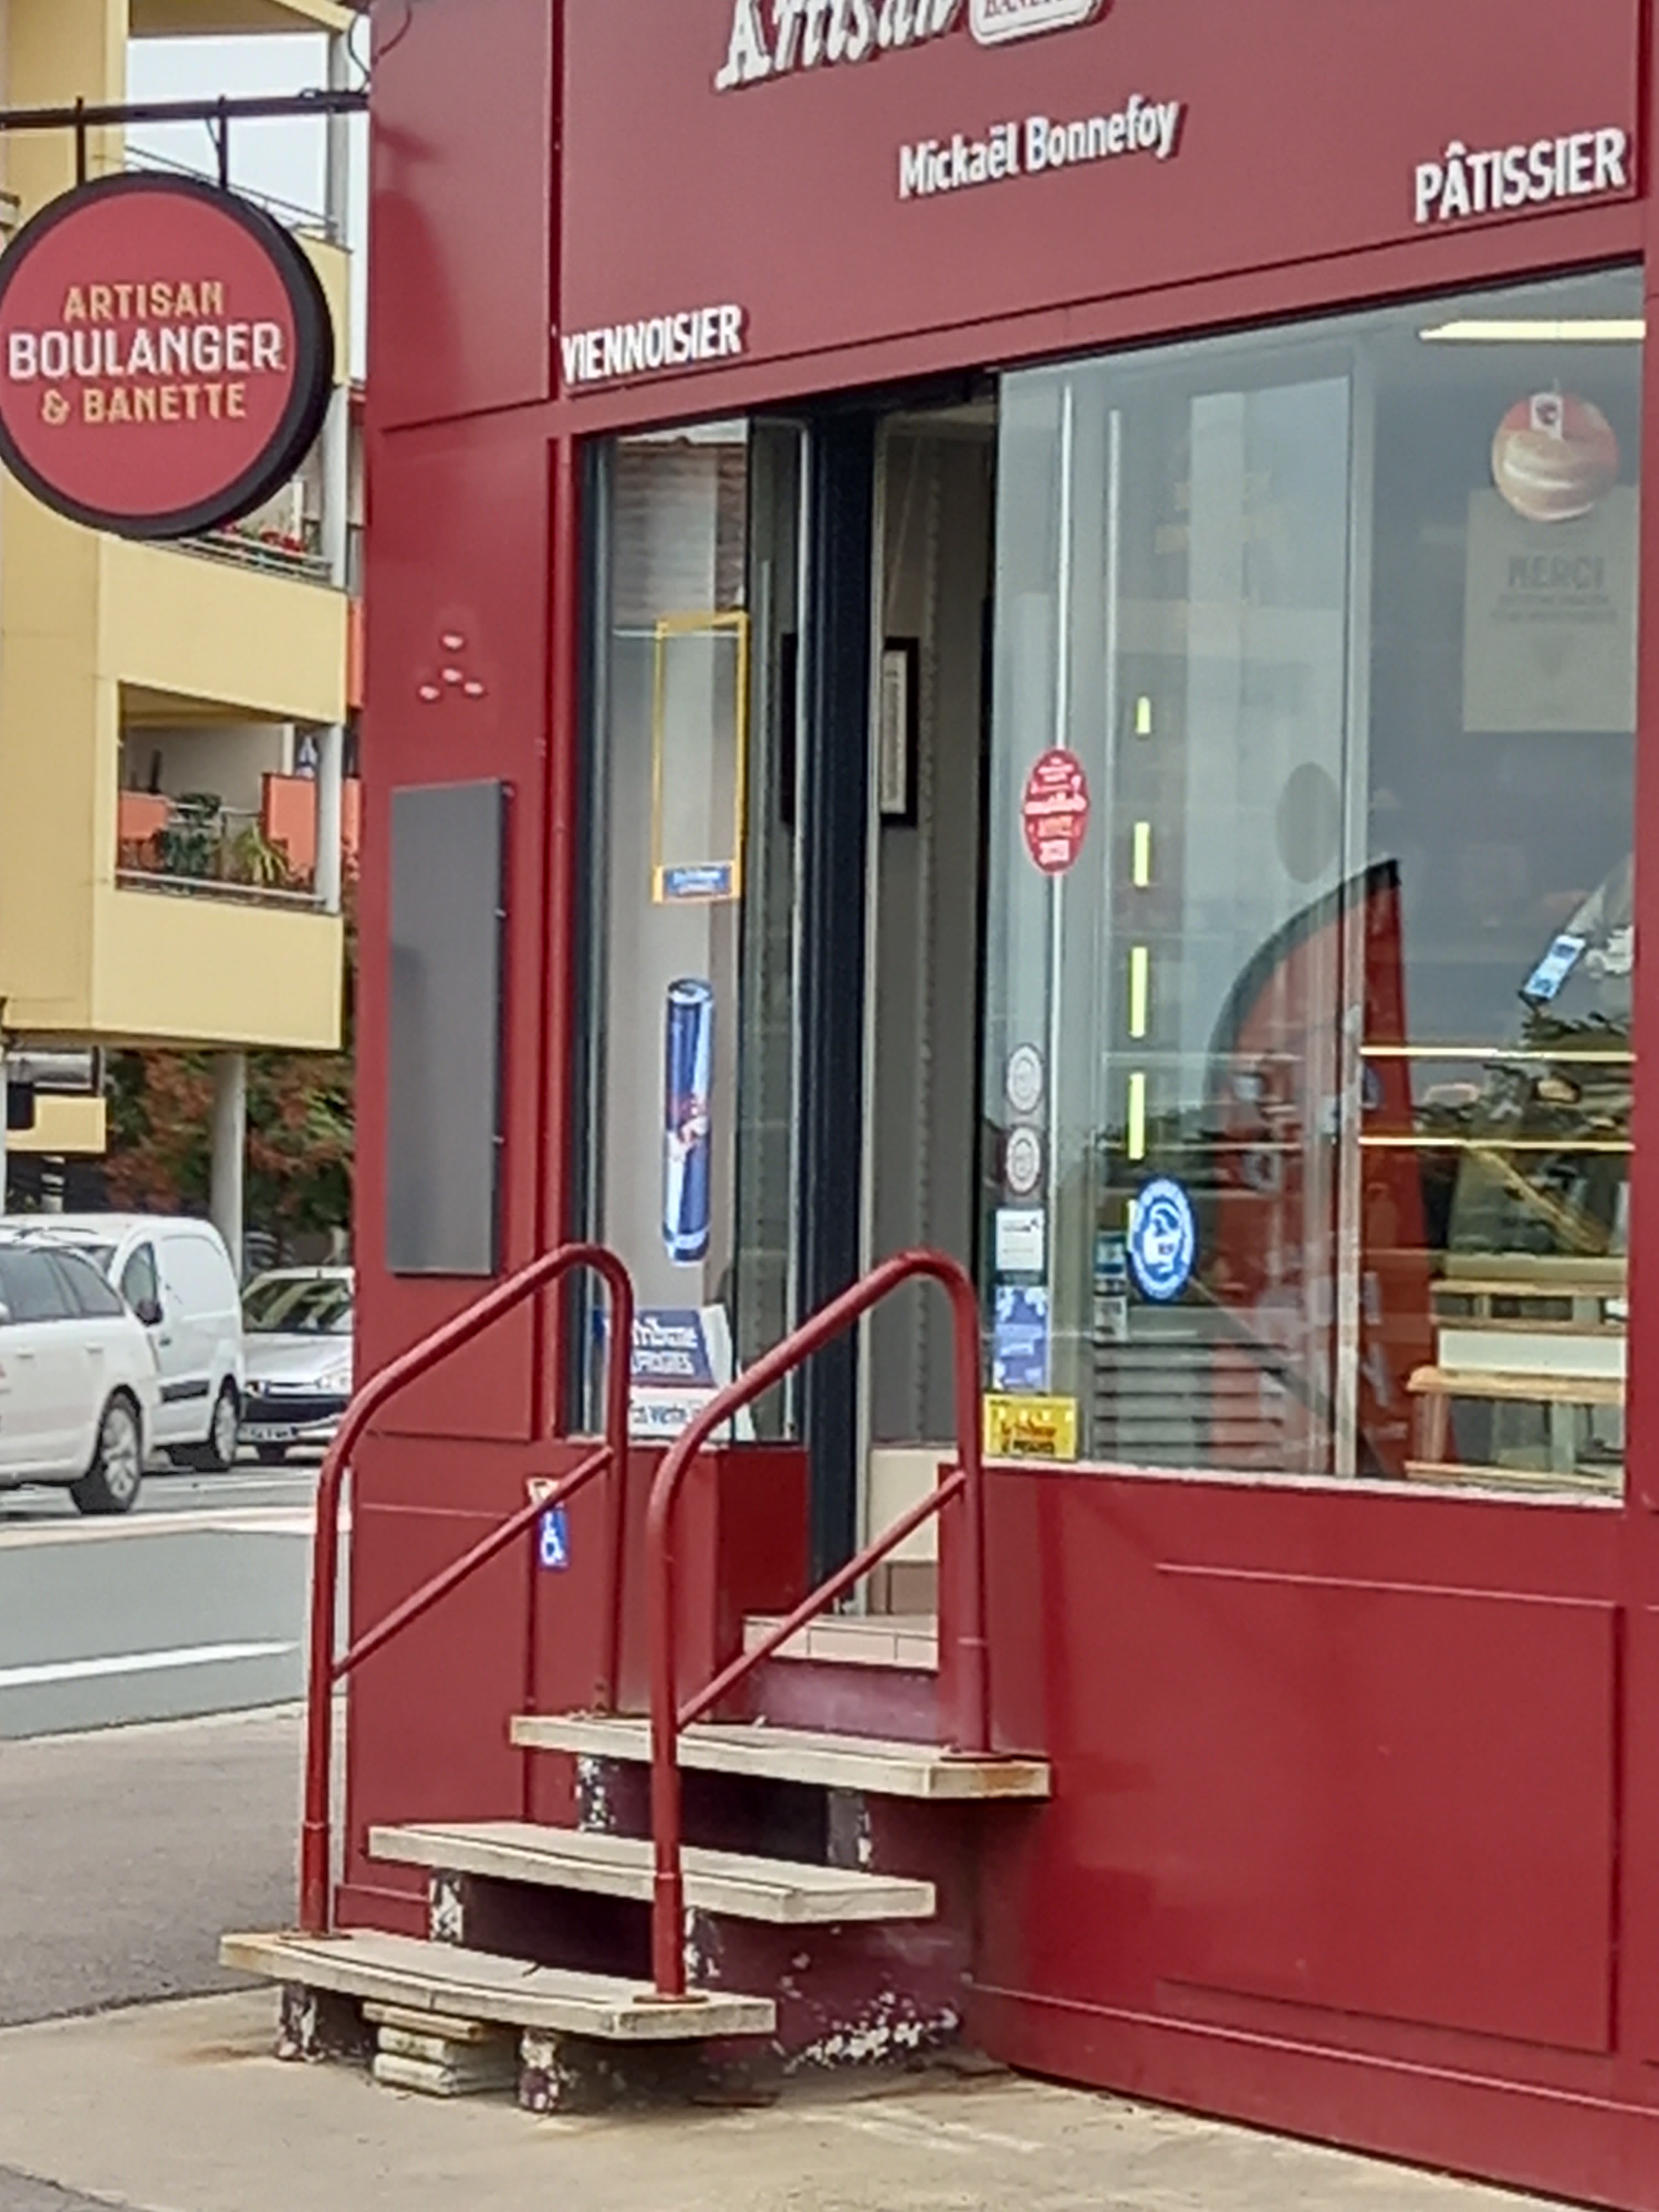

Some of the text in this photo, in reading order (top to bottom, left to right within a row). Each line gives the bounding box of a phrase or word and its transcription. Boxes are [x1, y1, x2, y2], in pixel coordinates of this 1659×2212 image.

[898, 93, 1180, 199] Mickaël Bonnefoy
[1415, 127, 1626, 223] PÂTISSIER
[64, 281, 223, 323] ARTISAN
[8, 322, 285, 379] BOULANGER
[561, 304, 742, 384] VIENNOISIER
[41, 382, 247, 425] & BANETTE
[1508, 555, 1603, 588] MERCI
